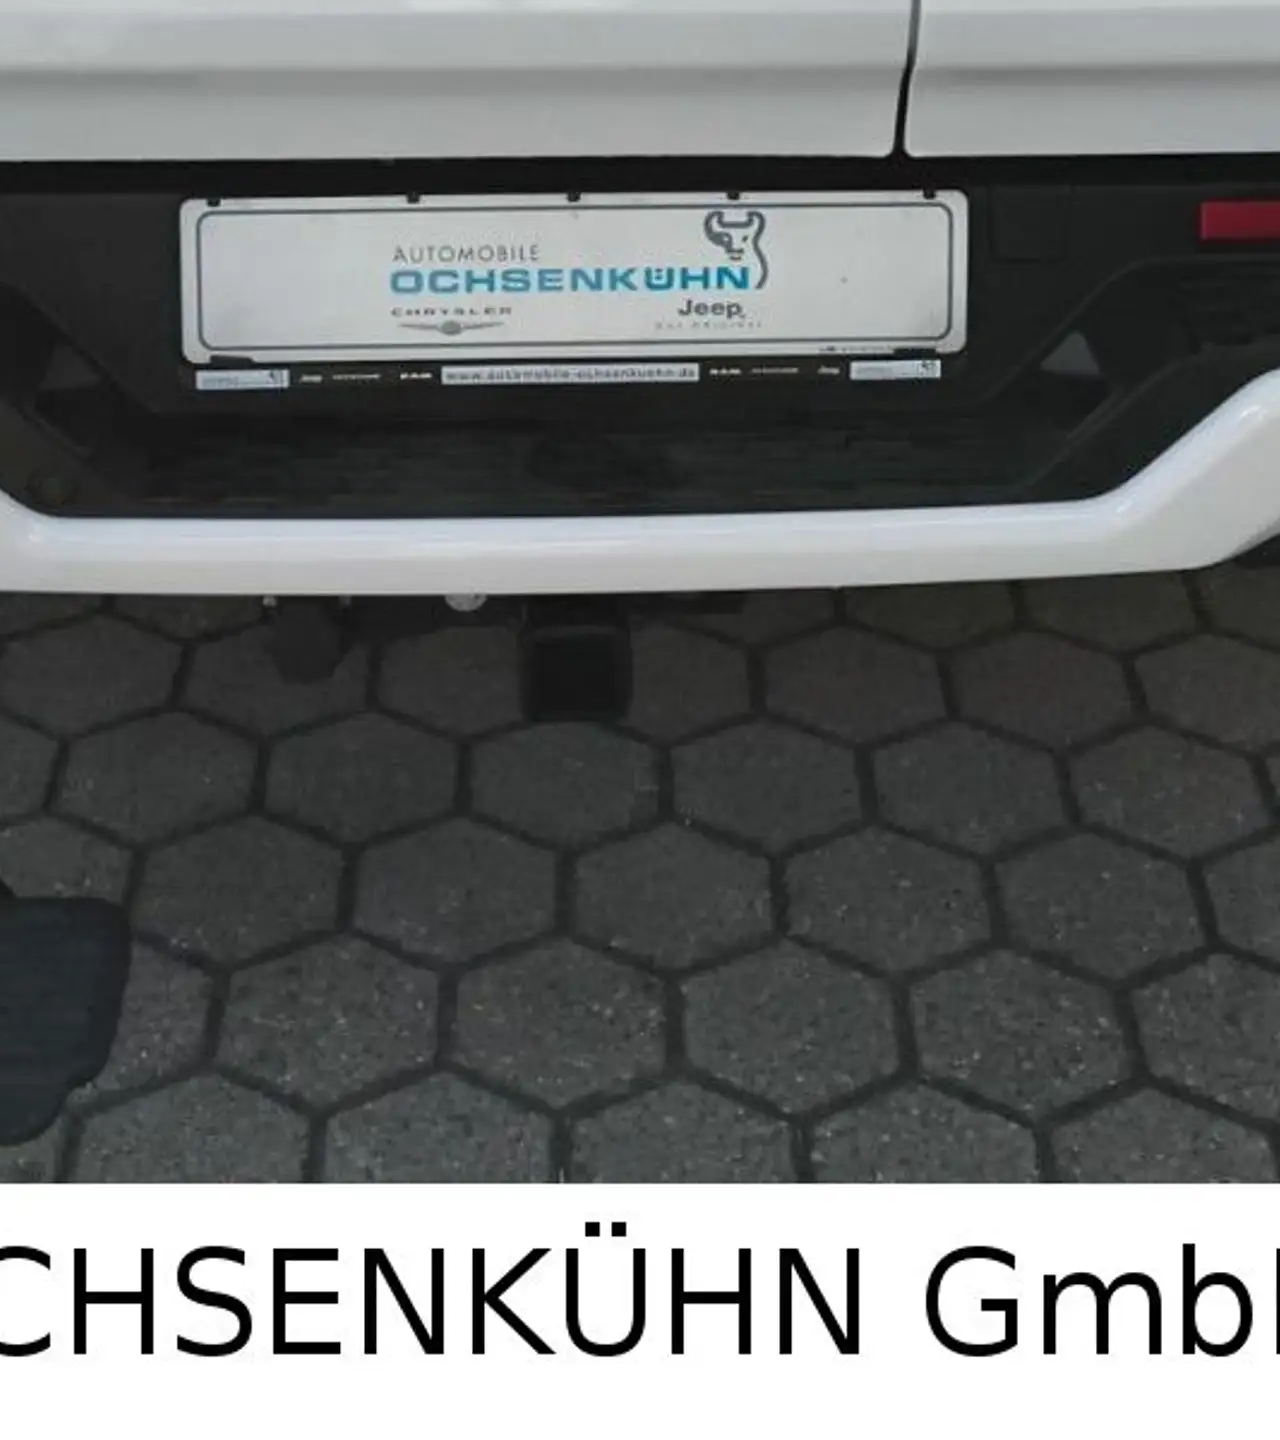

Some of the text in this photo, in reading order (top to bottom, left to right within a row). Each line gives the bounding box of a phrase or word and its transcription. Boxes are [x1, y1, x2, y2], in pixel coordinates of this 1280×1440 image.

[392, 243, 540, 262] AUTOMOBILE
[389, 264, 751, 294] OCHSENKÜHN
[390, 306, 513, 318] CHRYSLER
[677, 299, 745, 320] Jeep
